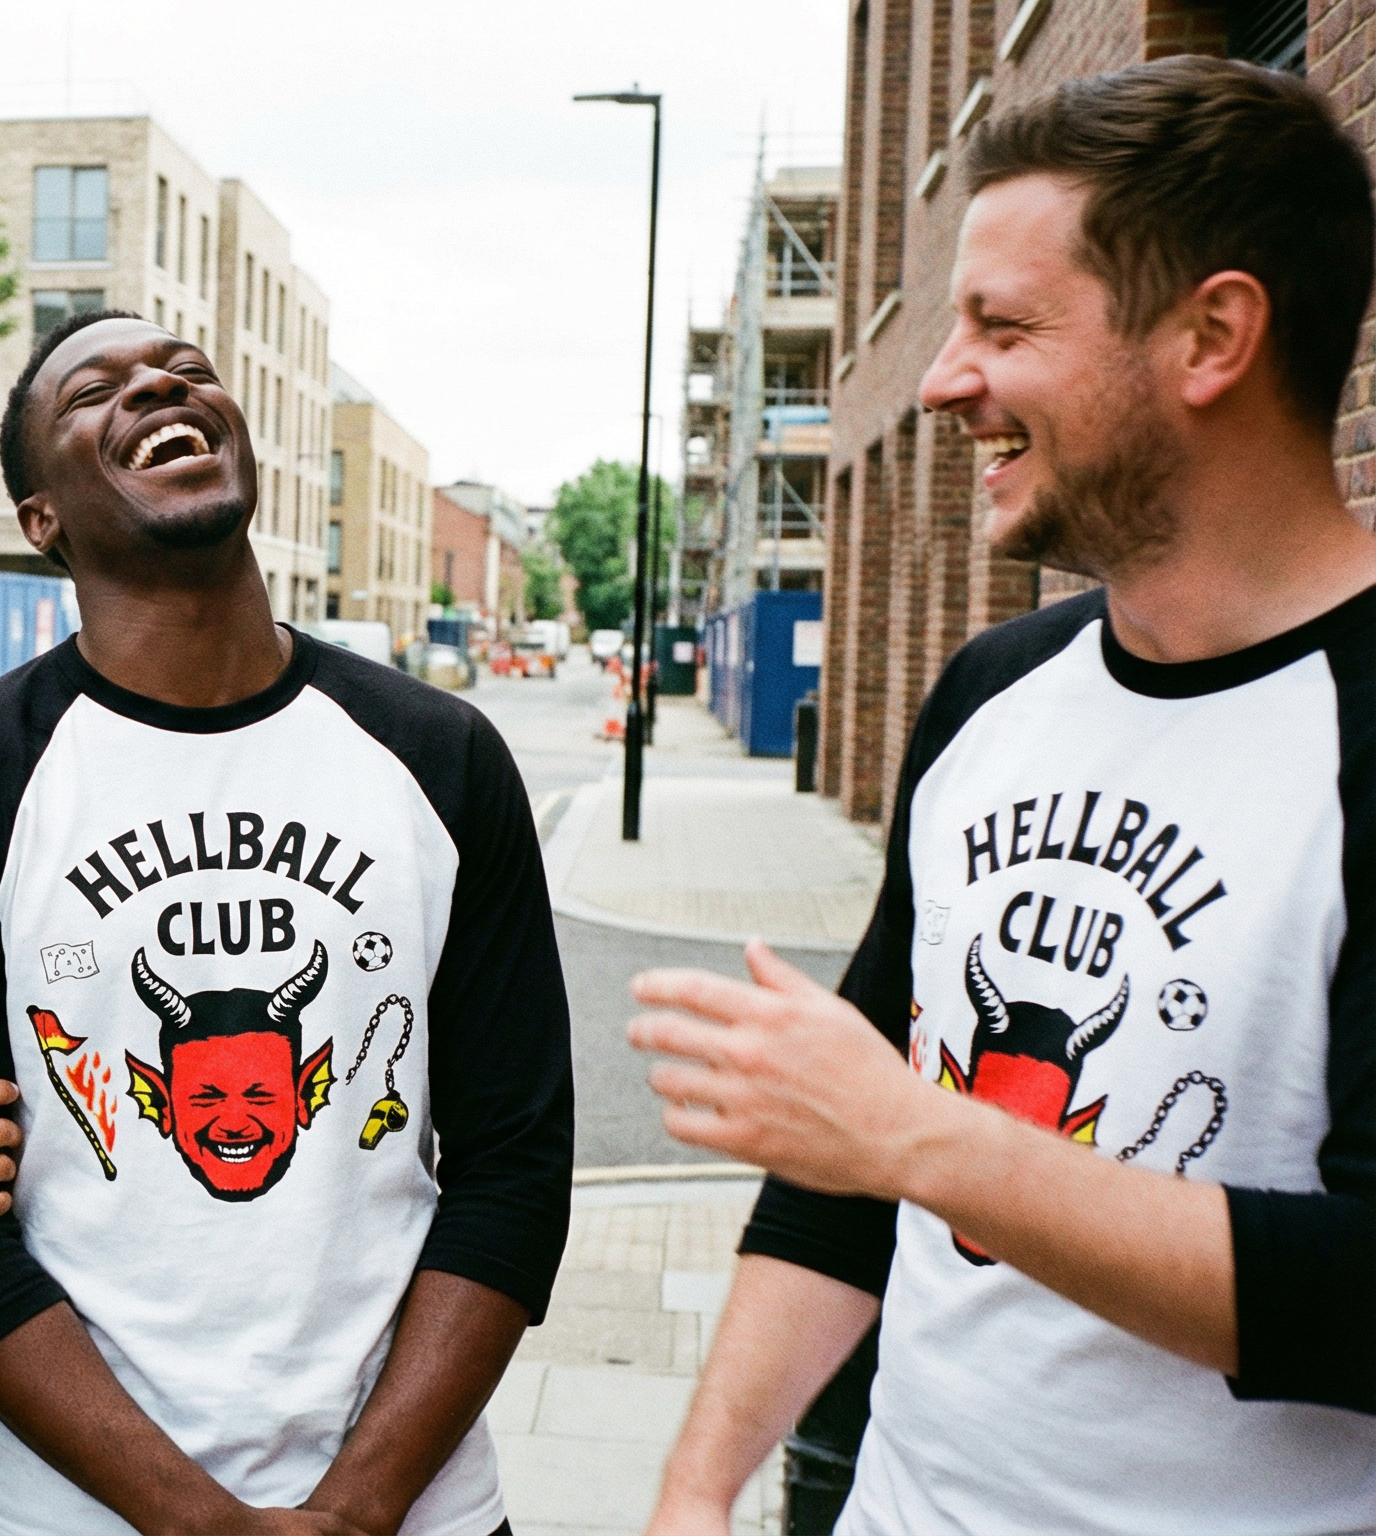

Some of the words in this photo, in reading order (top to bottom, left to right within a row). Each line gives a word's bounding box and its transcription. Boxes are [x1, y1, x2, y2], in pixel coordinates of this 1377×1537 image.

[64, 811, 376, 919] HELLBALL
[962, 790, 1228, 951] HELLBALL
[157, 898, 296, 956] CLUB
[999, 891, 1124, 979] CLUB
